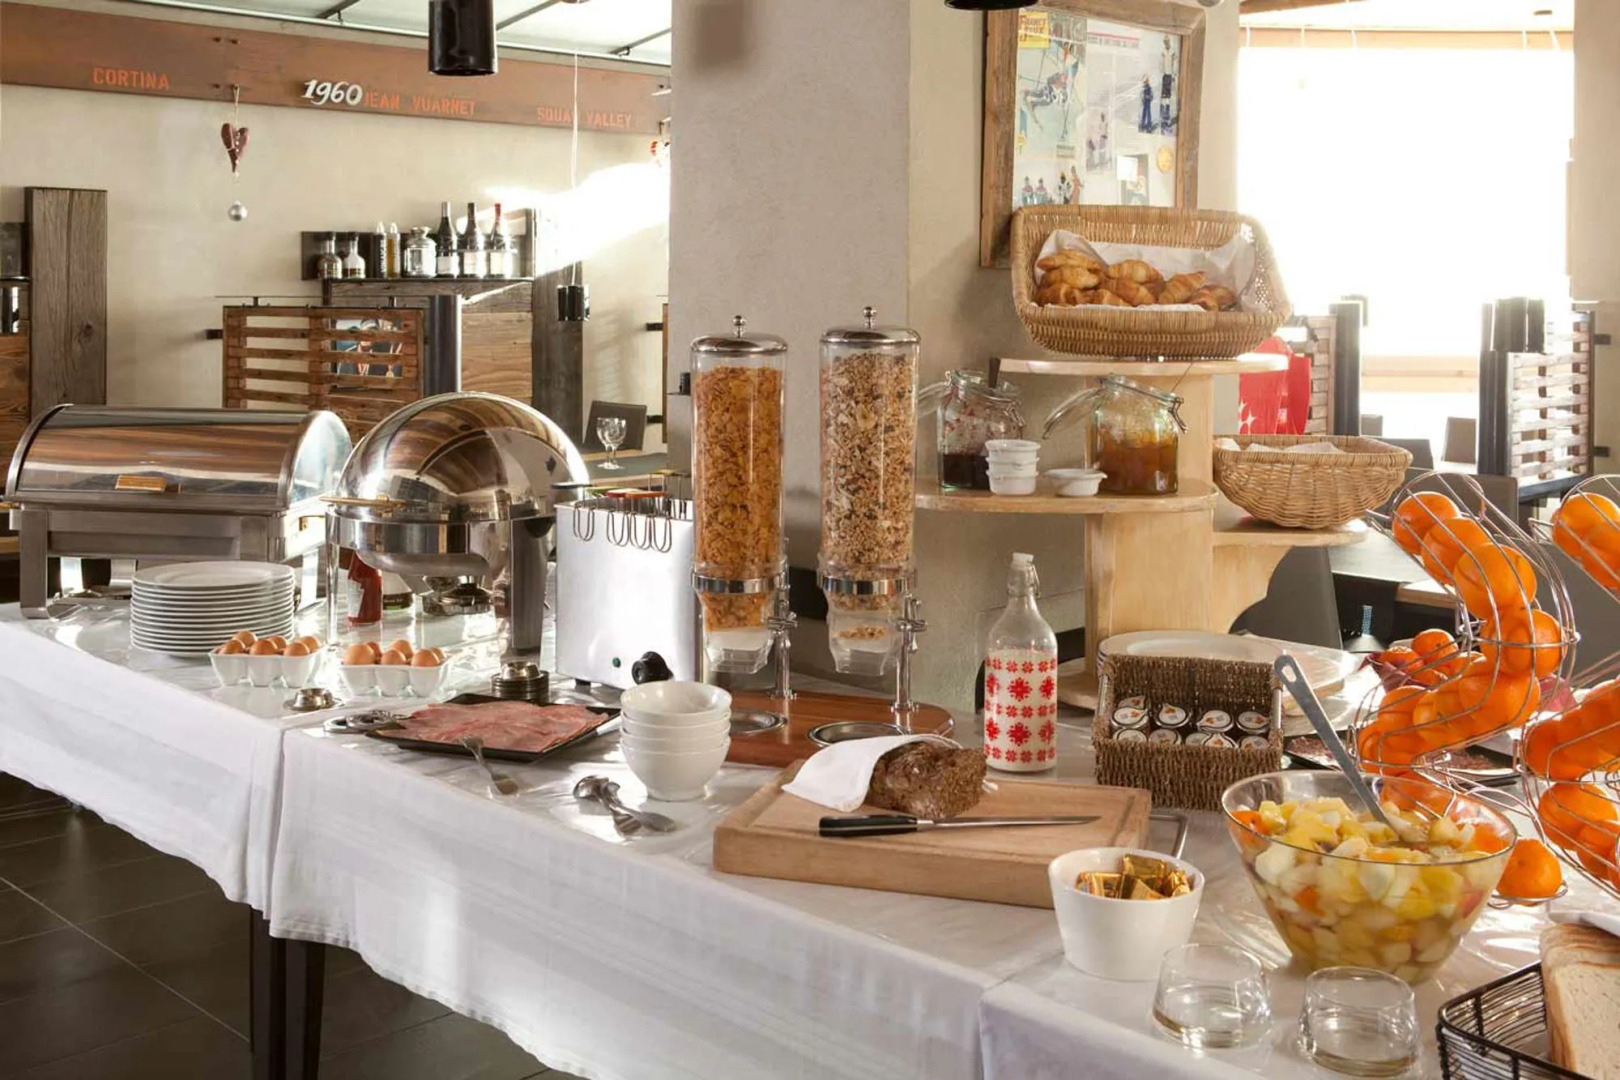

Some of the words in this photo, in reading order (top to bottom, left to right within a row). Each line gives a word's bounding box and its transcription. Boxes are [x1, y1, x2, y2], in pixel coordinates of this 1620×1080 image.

[93, 67, 169, 90] CORTINA
[301, 79, 363, 106] 1960
[363, 91, 400, 111] JEAN
[412, 95, 476, 116] VUARNET
[586, 110, 632, 129] VALLEY
